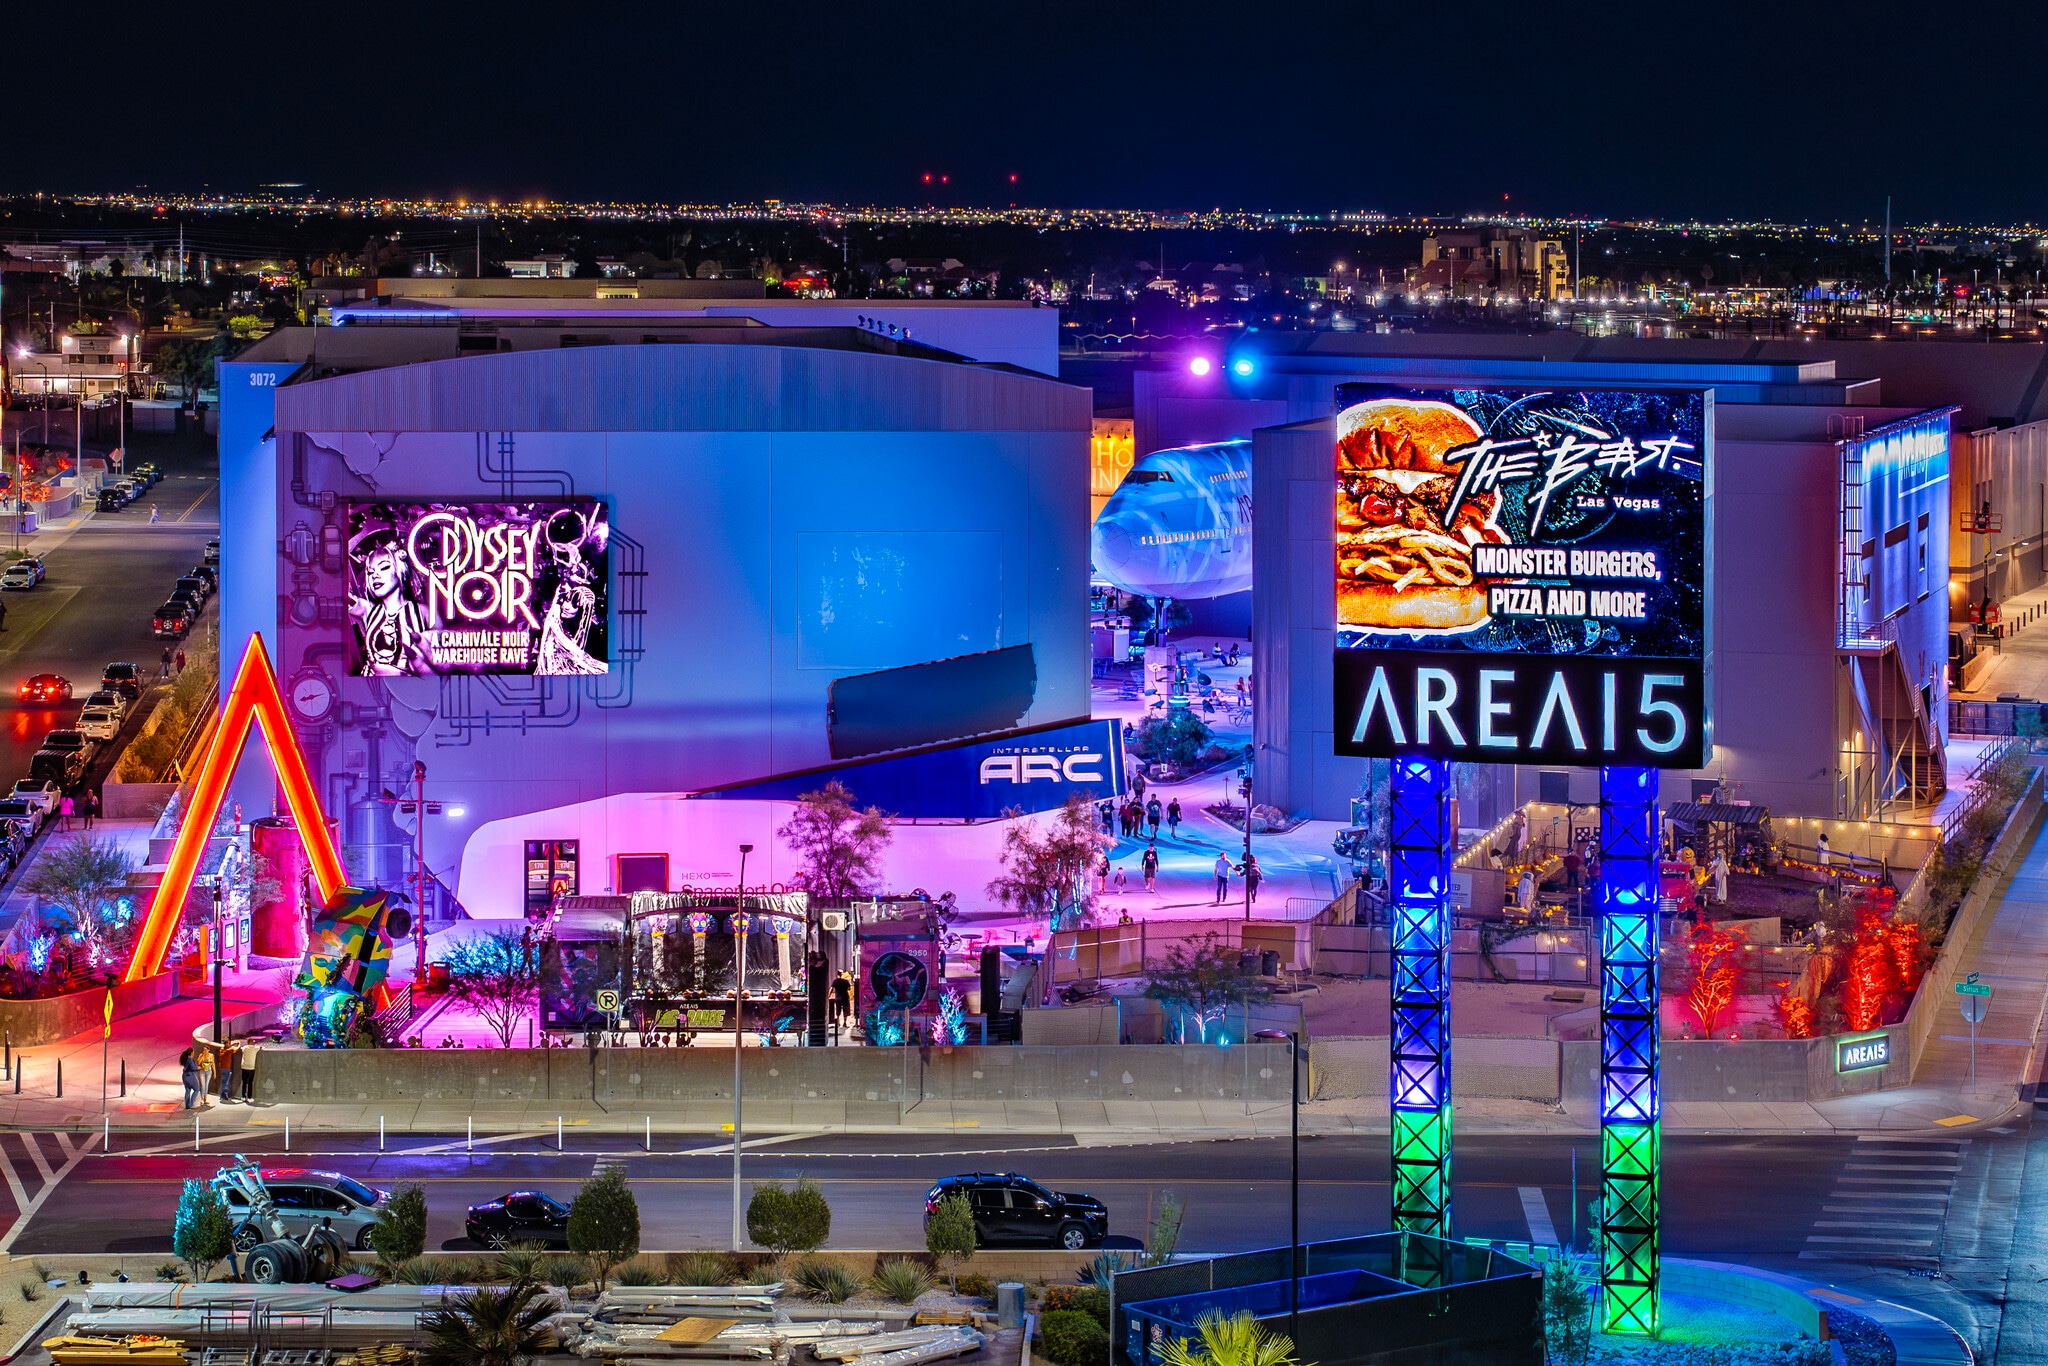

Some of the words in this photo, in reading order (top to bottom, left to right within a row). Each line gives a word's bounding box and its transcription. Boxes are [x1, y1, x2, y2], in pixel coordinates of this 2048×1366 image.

[250, 373, 276, 386] 3072
[1444, 438, 1539, 526] THE
[1576, 495, 1605, 508] Las
[1613, 496, 1660, 511] Vegas
[407, 511, 541, 579] ODYSSEY
[1476, 547, 1567, 575] MONSTER
[1570, 550, 1662, 581] BURGERS,
[428, 562, 541, 630] NOIR
[1491, 588, 1543, 615] PIZZA
[1546, 589, 1586, 616] AND
[1590, 591, 1646, 618] MORE
[431, 631, 439, 647] A
[502, 631, 529, 647] NOIR
[432, 648, 498, 664] WAREHOUSE
[500, 648, 529, 664] RAVE
[1351, 665, 1687, 753] AREA15
[992, 745, 1090, 754] INTERSTELLAR
[980, 753, 1104, 785] ARC
[681, 872, 711, 880] HEXO
[1845, 1043, 1886, 1065] AREA15
